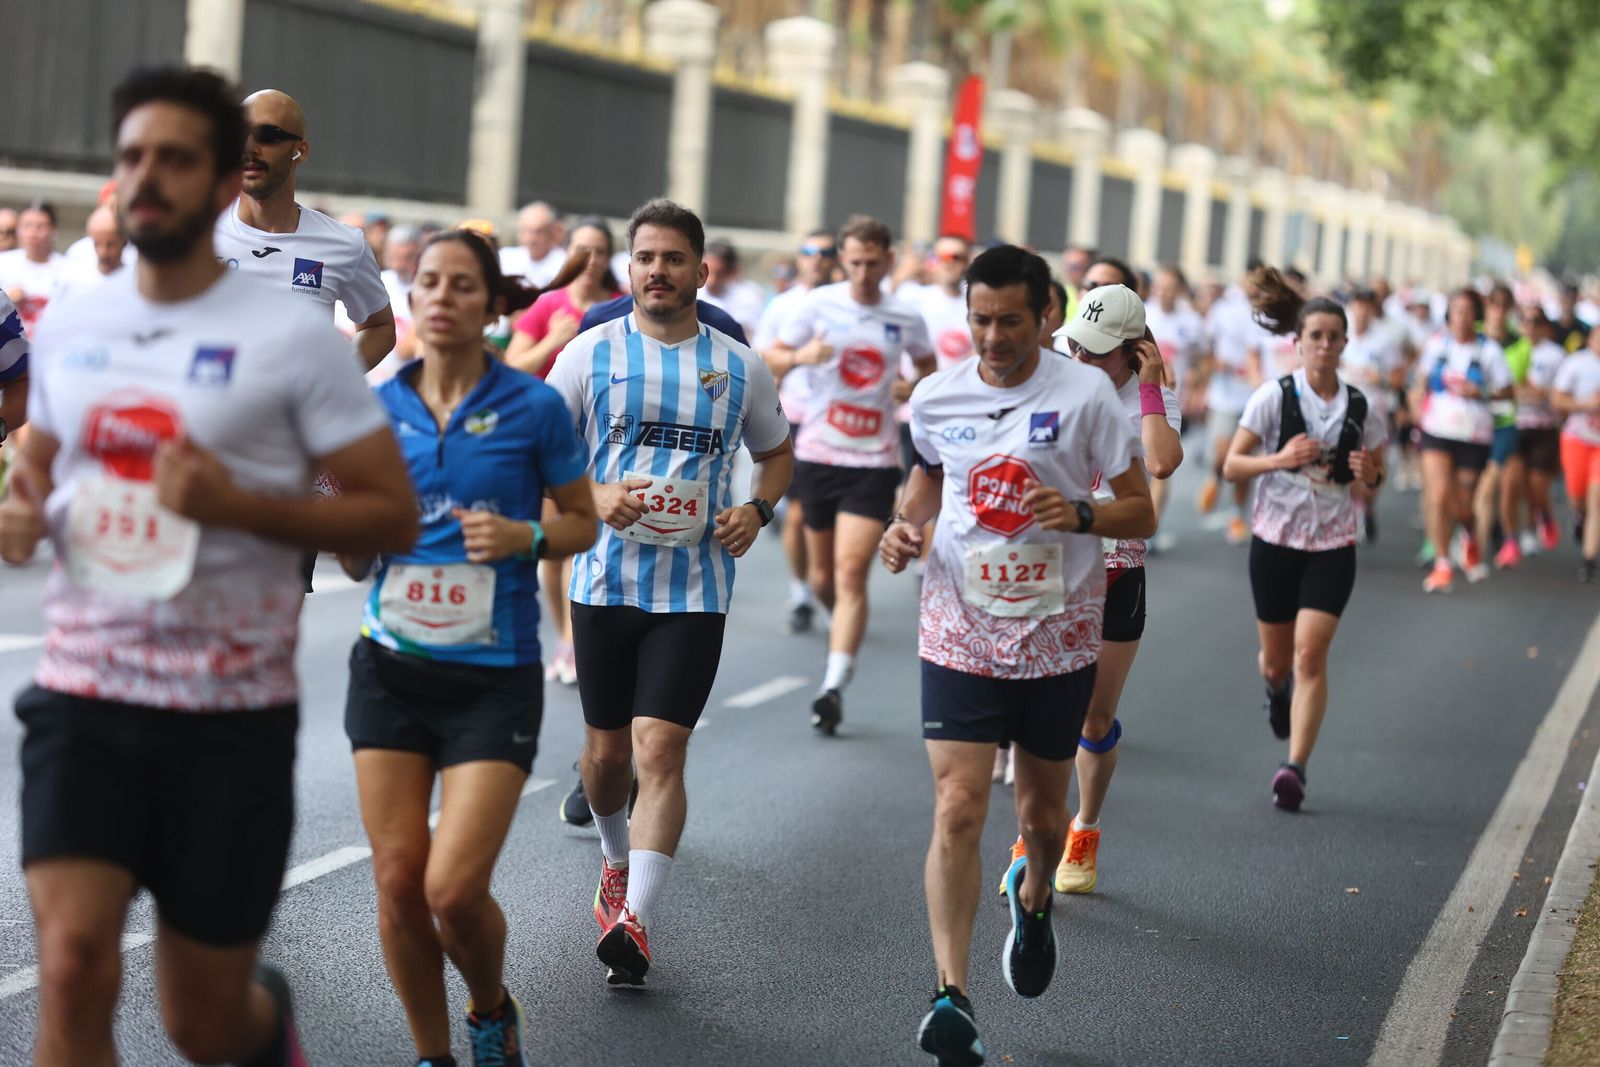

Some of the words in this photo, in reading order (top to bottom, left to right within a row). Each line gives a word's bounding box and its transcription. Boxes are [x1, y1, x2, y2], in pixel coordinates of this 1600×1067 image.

[291, 272, 316, 286] AXA
[1083, 300, 1104, 323] NY
[634, 421, 725, 456] TESESA
[978, 475, 1025, 499] PONL
[980, 562, 1047, 582] 1127
[406, 580, 466, 604] 816
